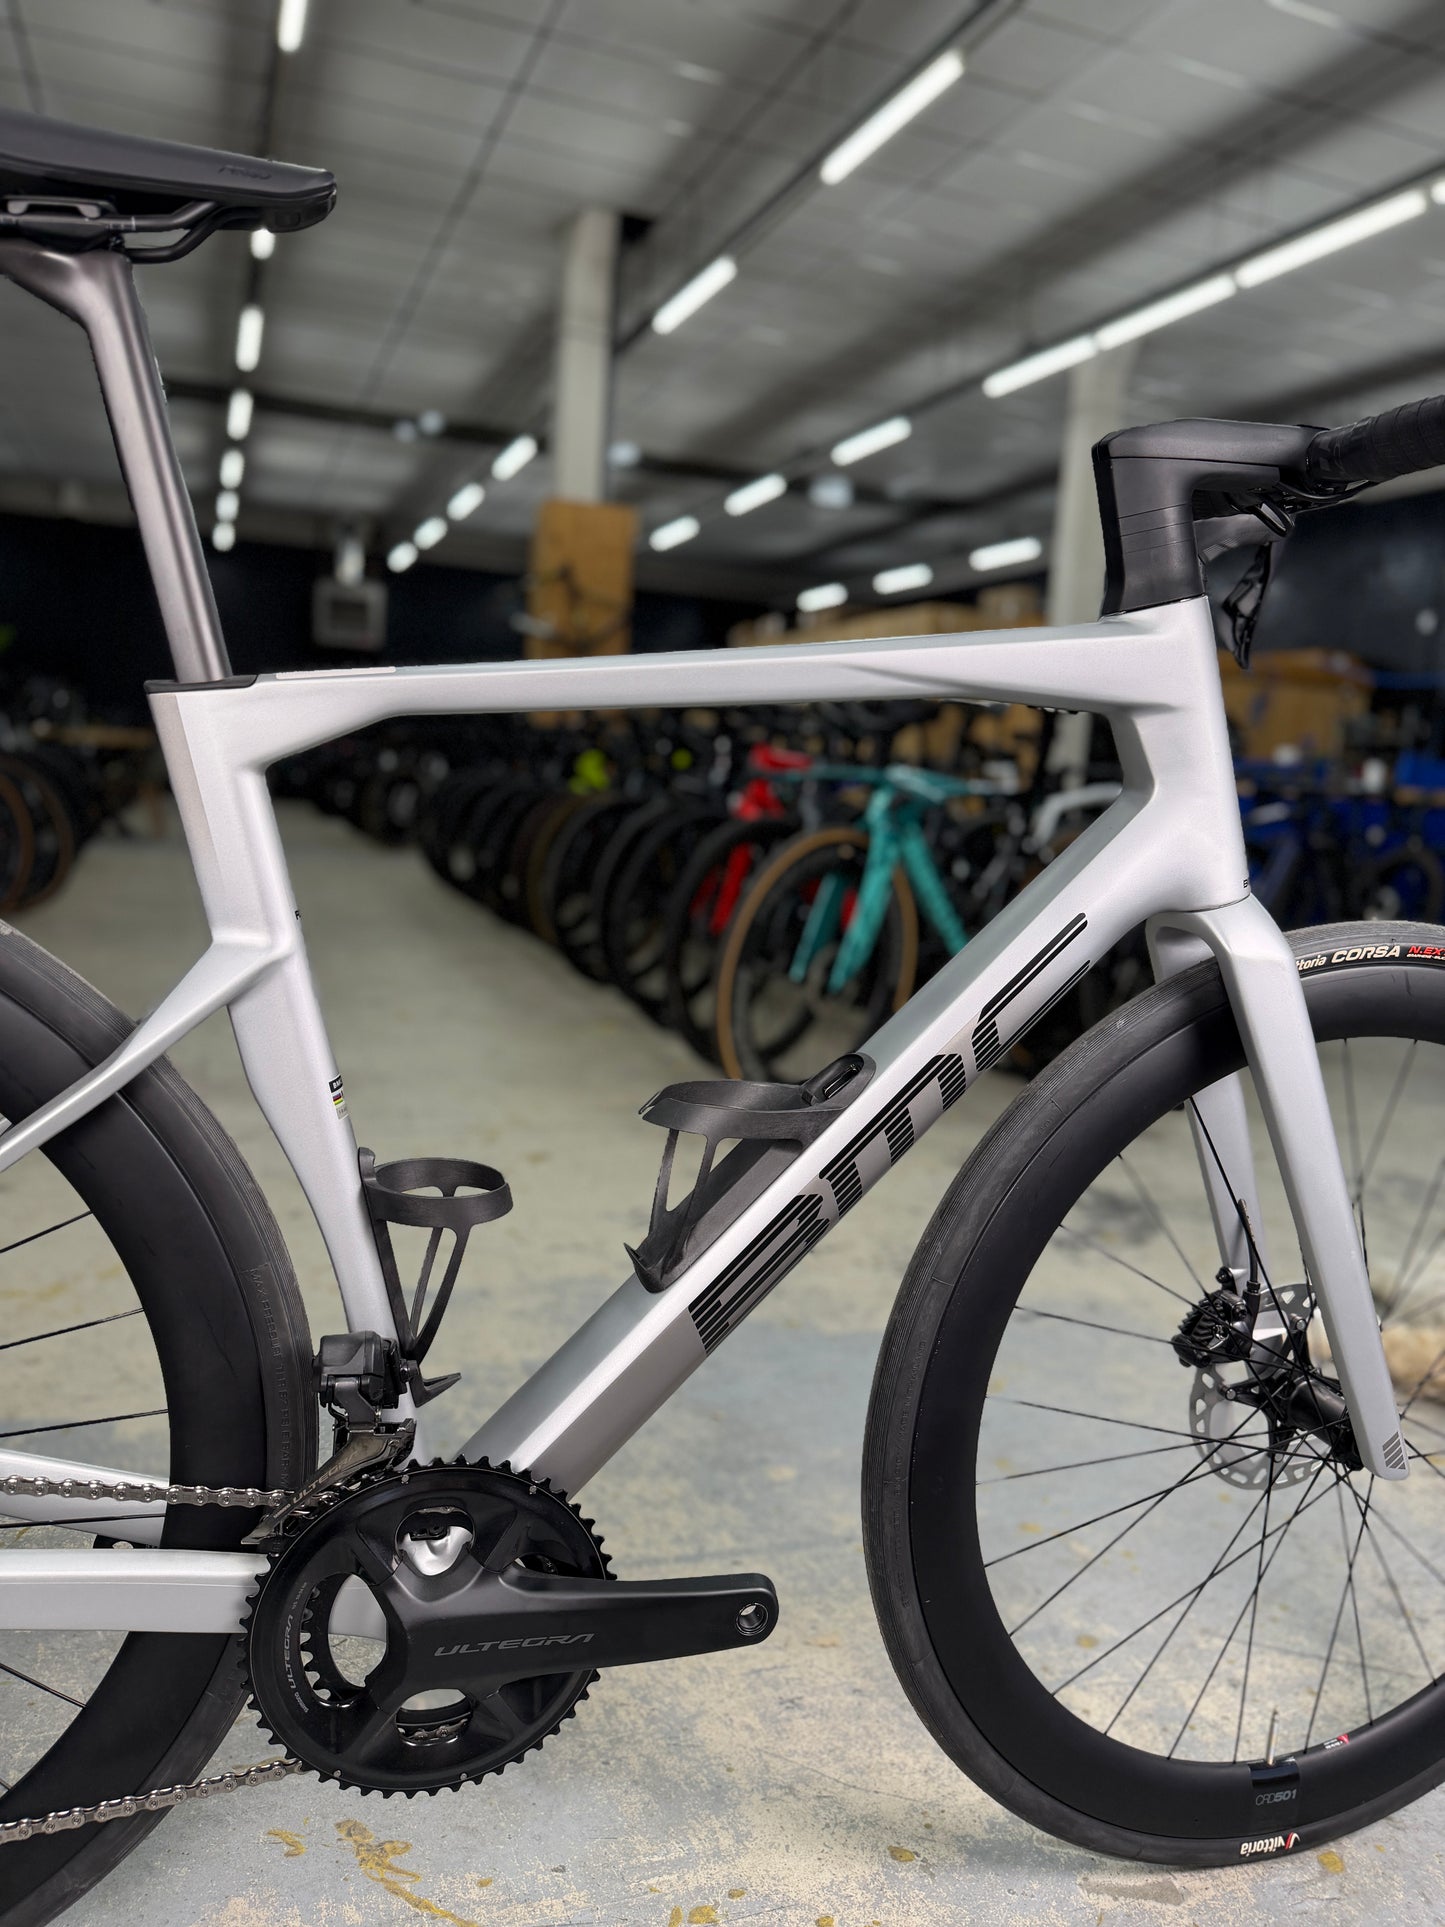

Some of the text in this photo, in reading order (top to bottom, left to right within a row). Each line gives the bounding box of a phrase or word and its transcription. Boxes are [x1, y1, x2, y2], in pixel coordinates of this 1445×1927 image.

[1331, 945, 1400, 964] CORSA
[284, 1614, 297, 1689] ULTEGRA
[434, 1632, 595, 1657] ULTEGRA
[1240, 1835, 1285, 1857] vittoria
